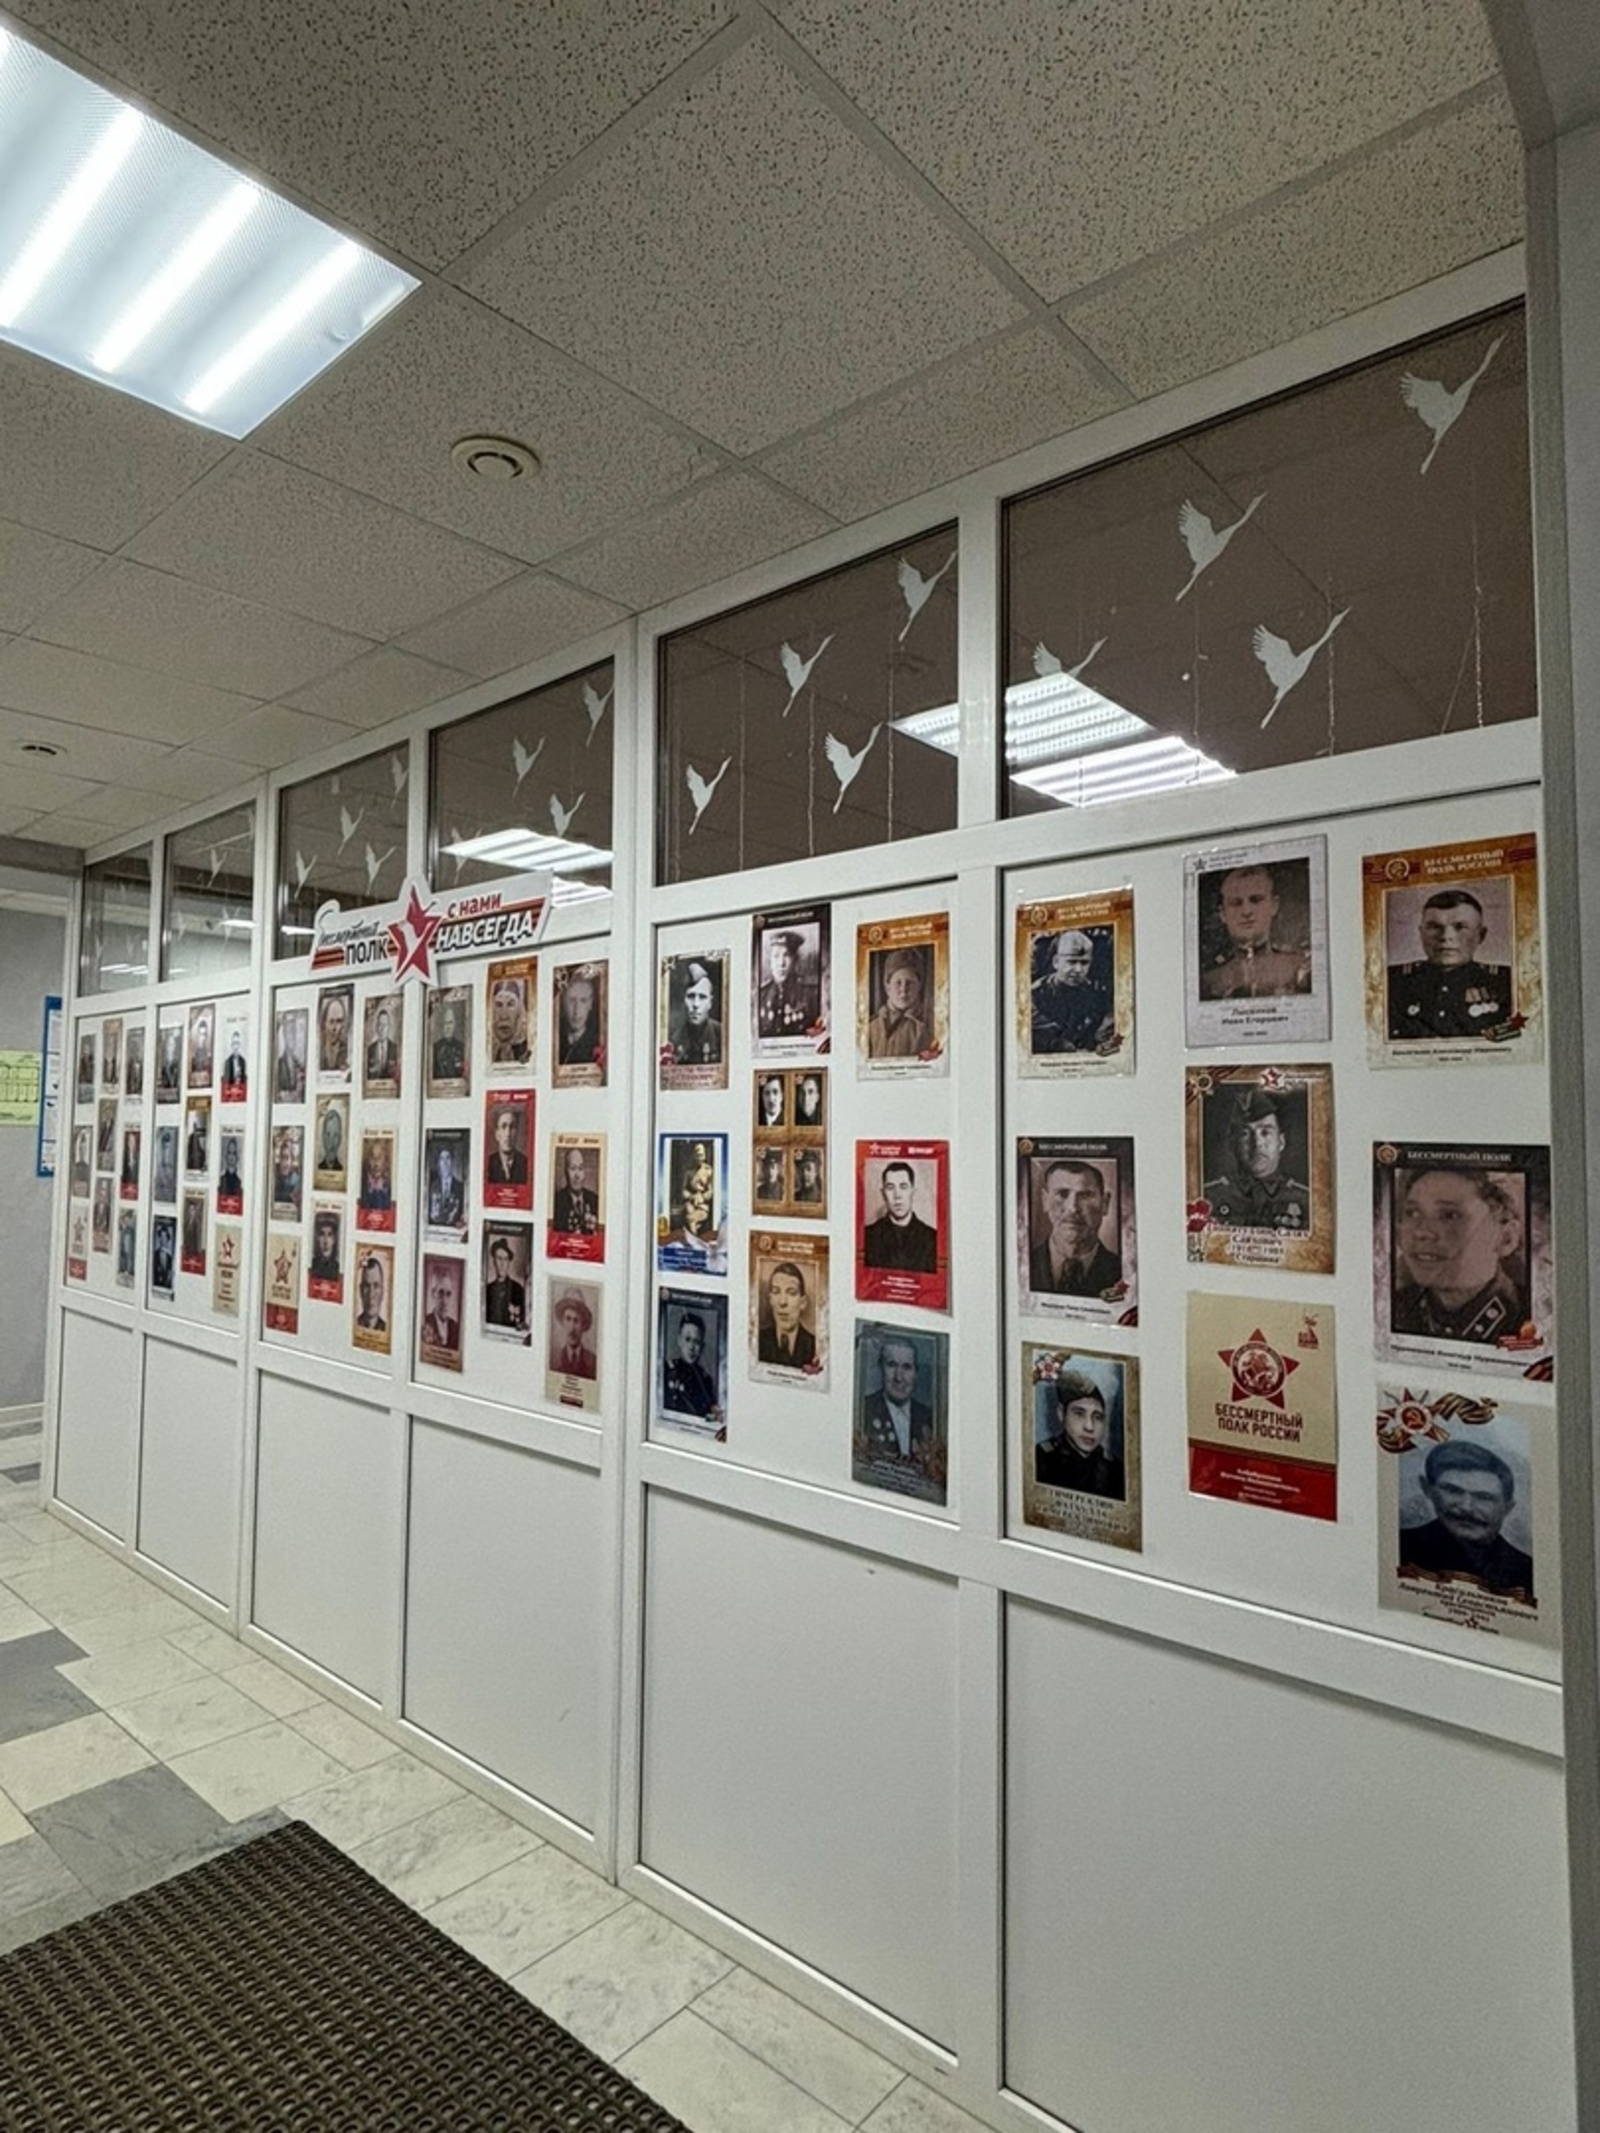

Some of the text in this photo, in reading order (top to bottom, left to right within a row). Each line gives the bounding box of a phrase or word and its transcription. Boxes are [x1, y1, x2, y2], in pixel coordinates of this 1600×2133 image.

[436, 909, 534, 953] НАВСЕГДА
[345, 938, 388, 966] ПОЛК
[1215, 1402, 1303, 1429] БЕССМЕРТНЫЙ
[1218, 1417, 1301, 1443] ПОЛК РОССИИ
